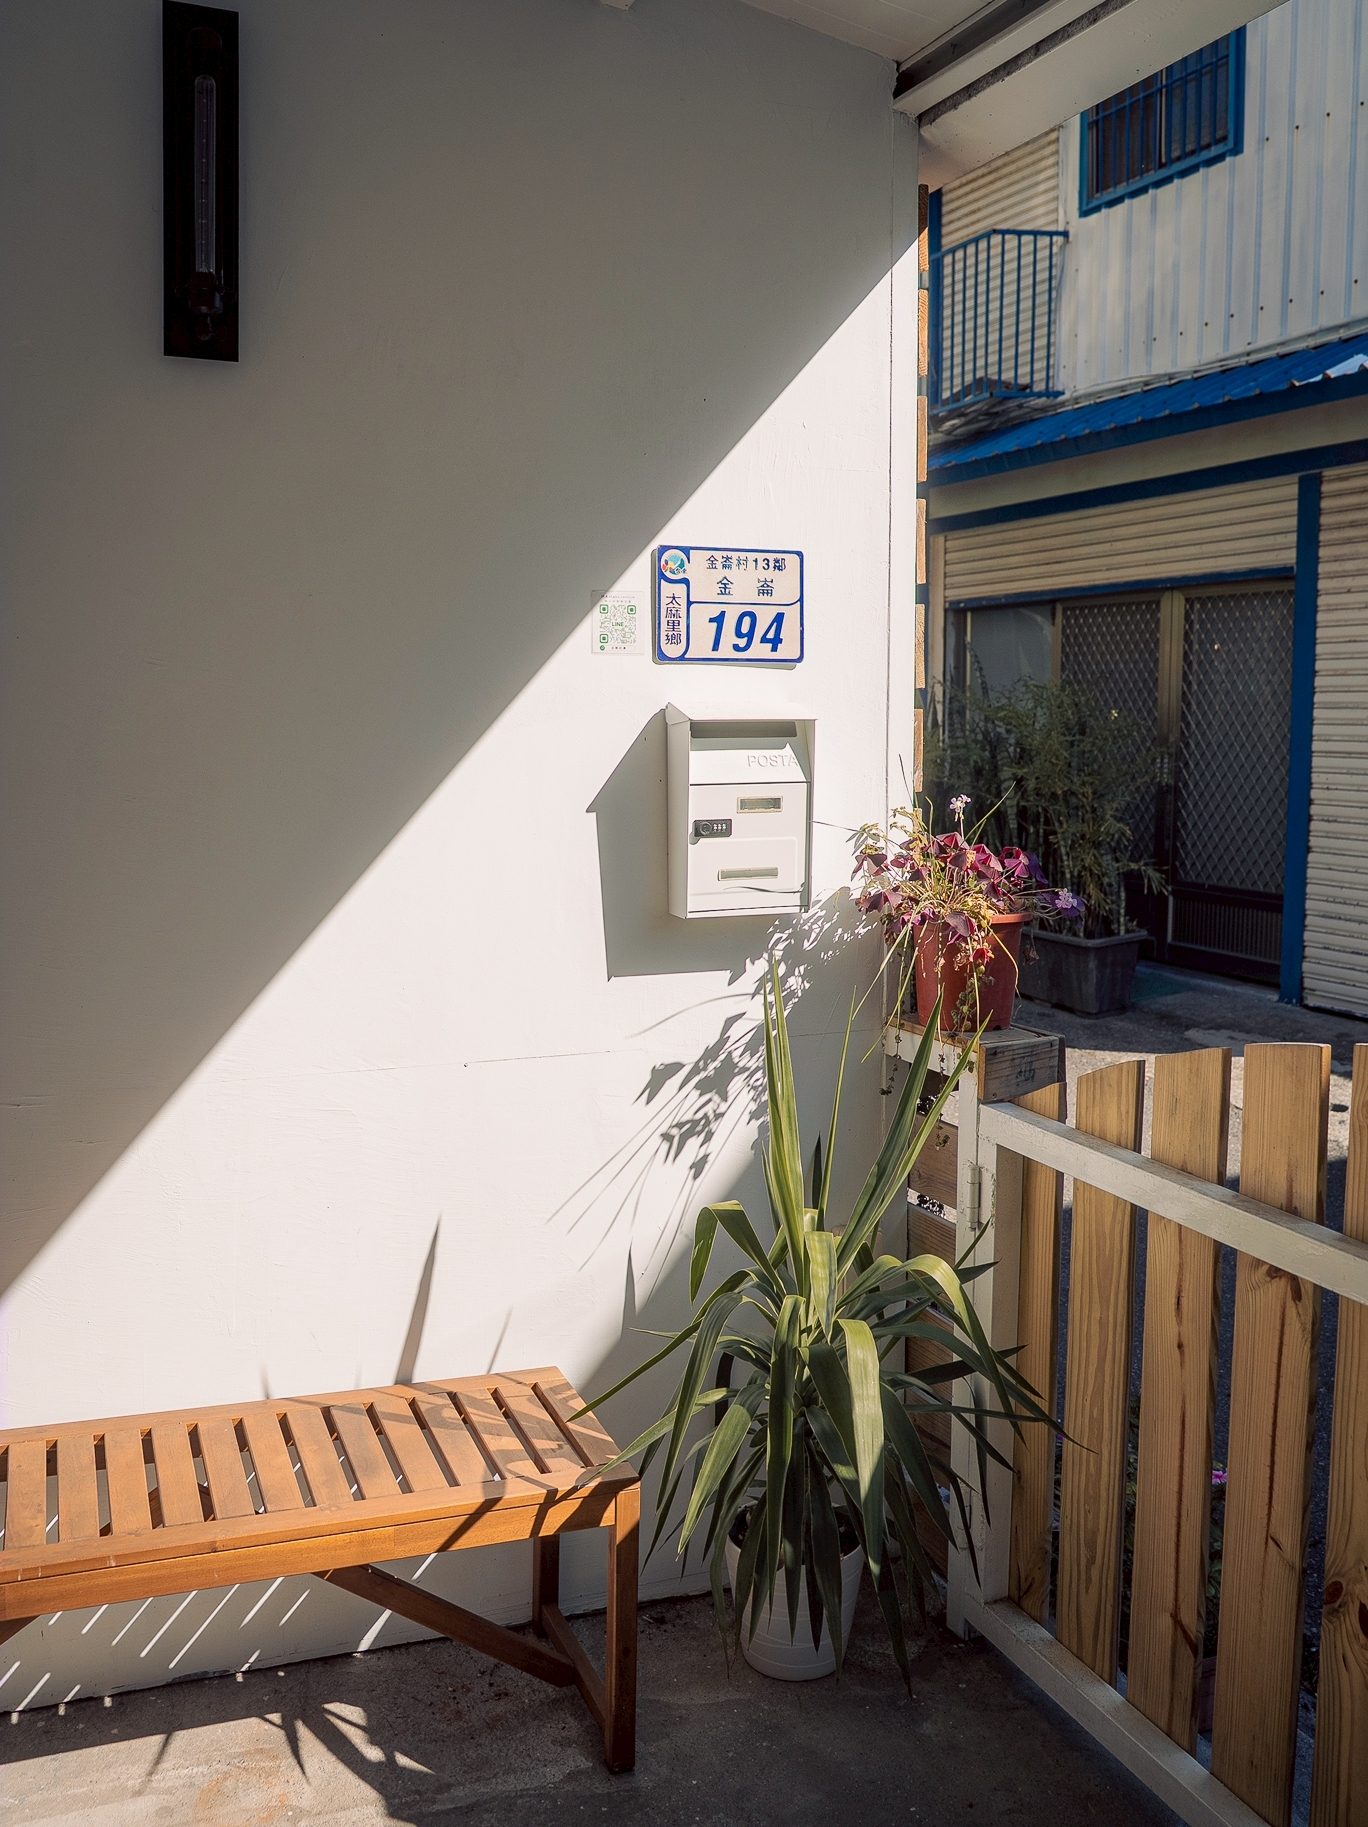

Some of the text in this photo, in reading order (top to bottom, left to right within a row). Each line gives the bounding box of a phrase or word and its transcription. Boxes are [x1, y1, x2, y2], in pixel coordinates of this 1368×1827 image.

[664, 593, 682, 646] 太麻里鄉
[708, 610, 786, 653] 194
[747, 754, 799, 767] POSTA
